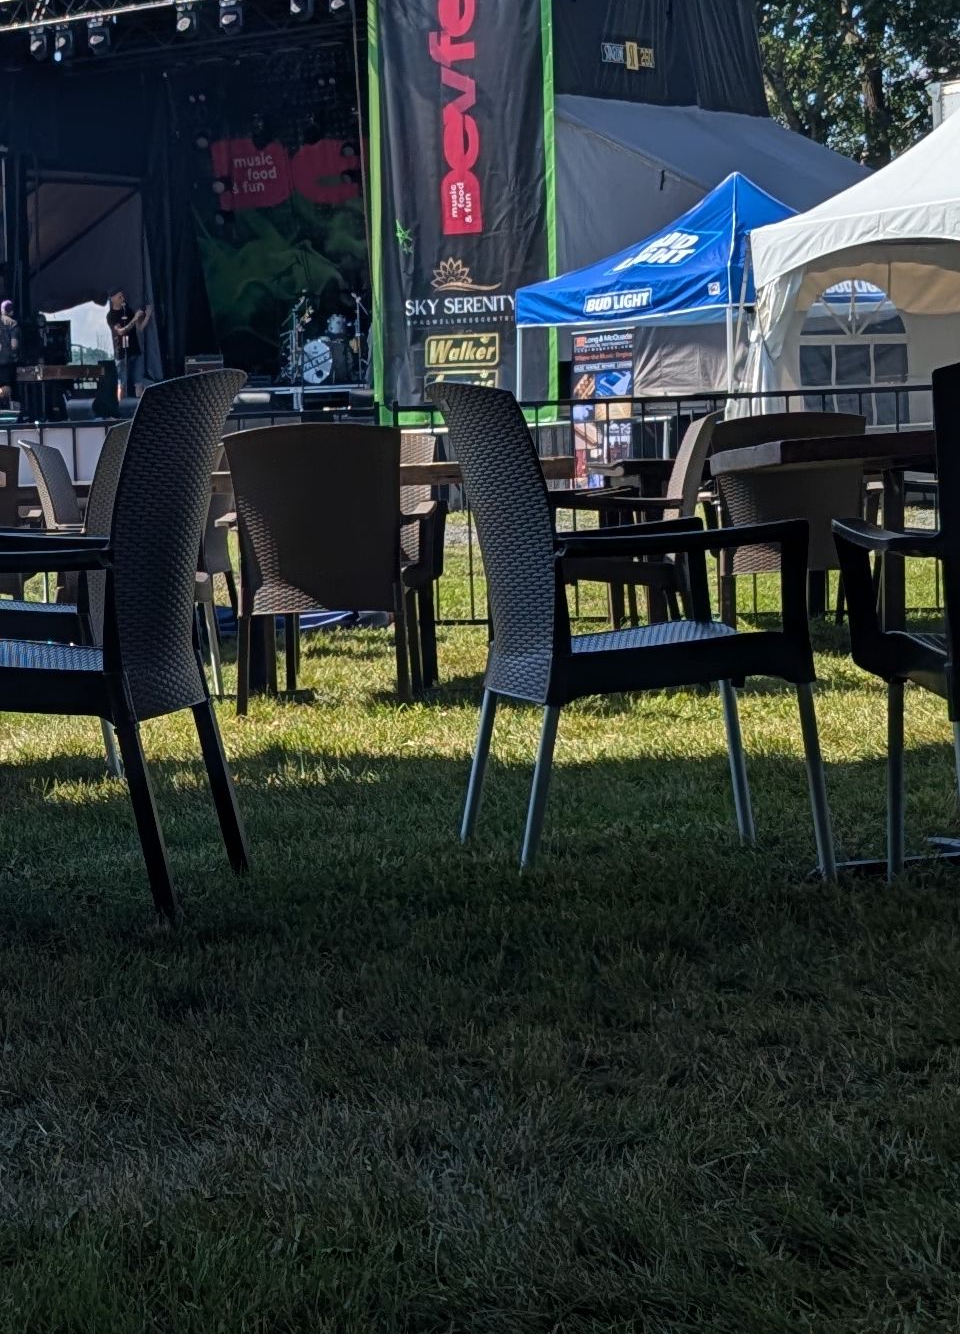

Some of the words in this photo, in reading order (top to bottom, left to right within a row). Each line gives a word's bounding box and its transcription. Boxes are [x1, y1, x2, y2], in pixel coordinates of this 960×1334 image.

[233, 152, 274, 168] music
[247, 165, 278, 181] food
[242, 181, 266, 193] fun
[456, 181, 465, 208] food
[449, 184, 458, 218] music
[464, 193, 472, 213] fun
[405, 298, 440, 317] SKY
[444, 294, 516, 315] SERENITY
[586, 297, 612, 313] BUD
[613, 292, 650, 309] LIGHT
[429, 339, 497, 364] Walker
